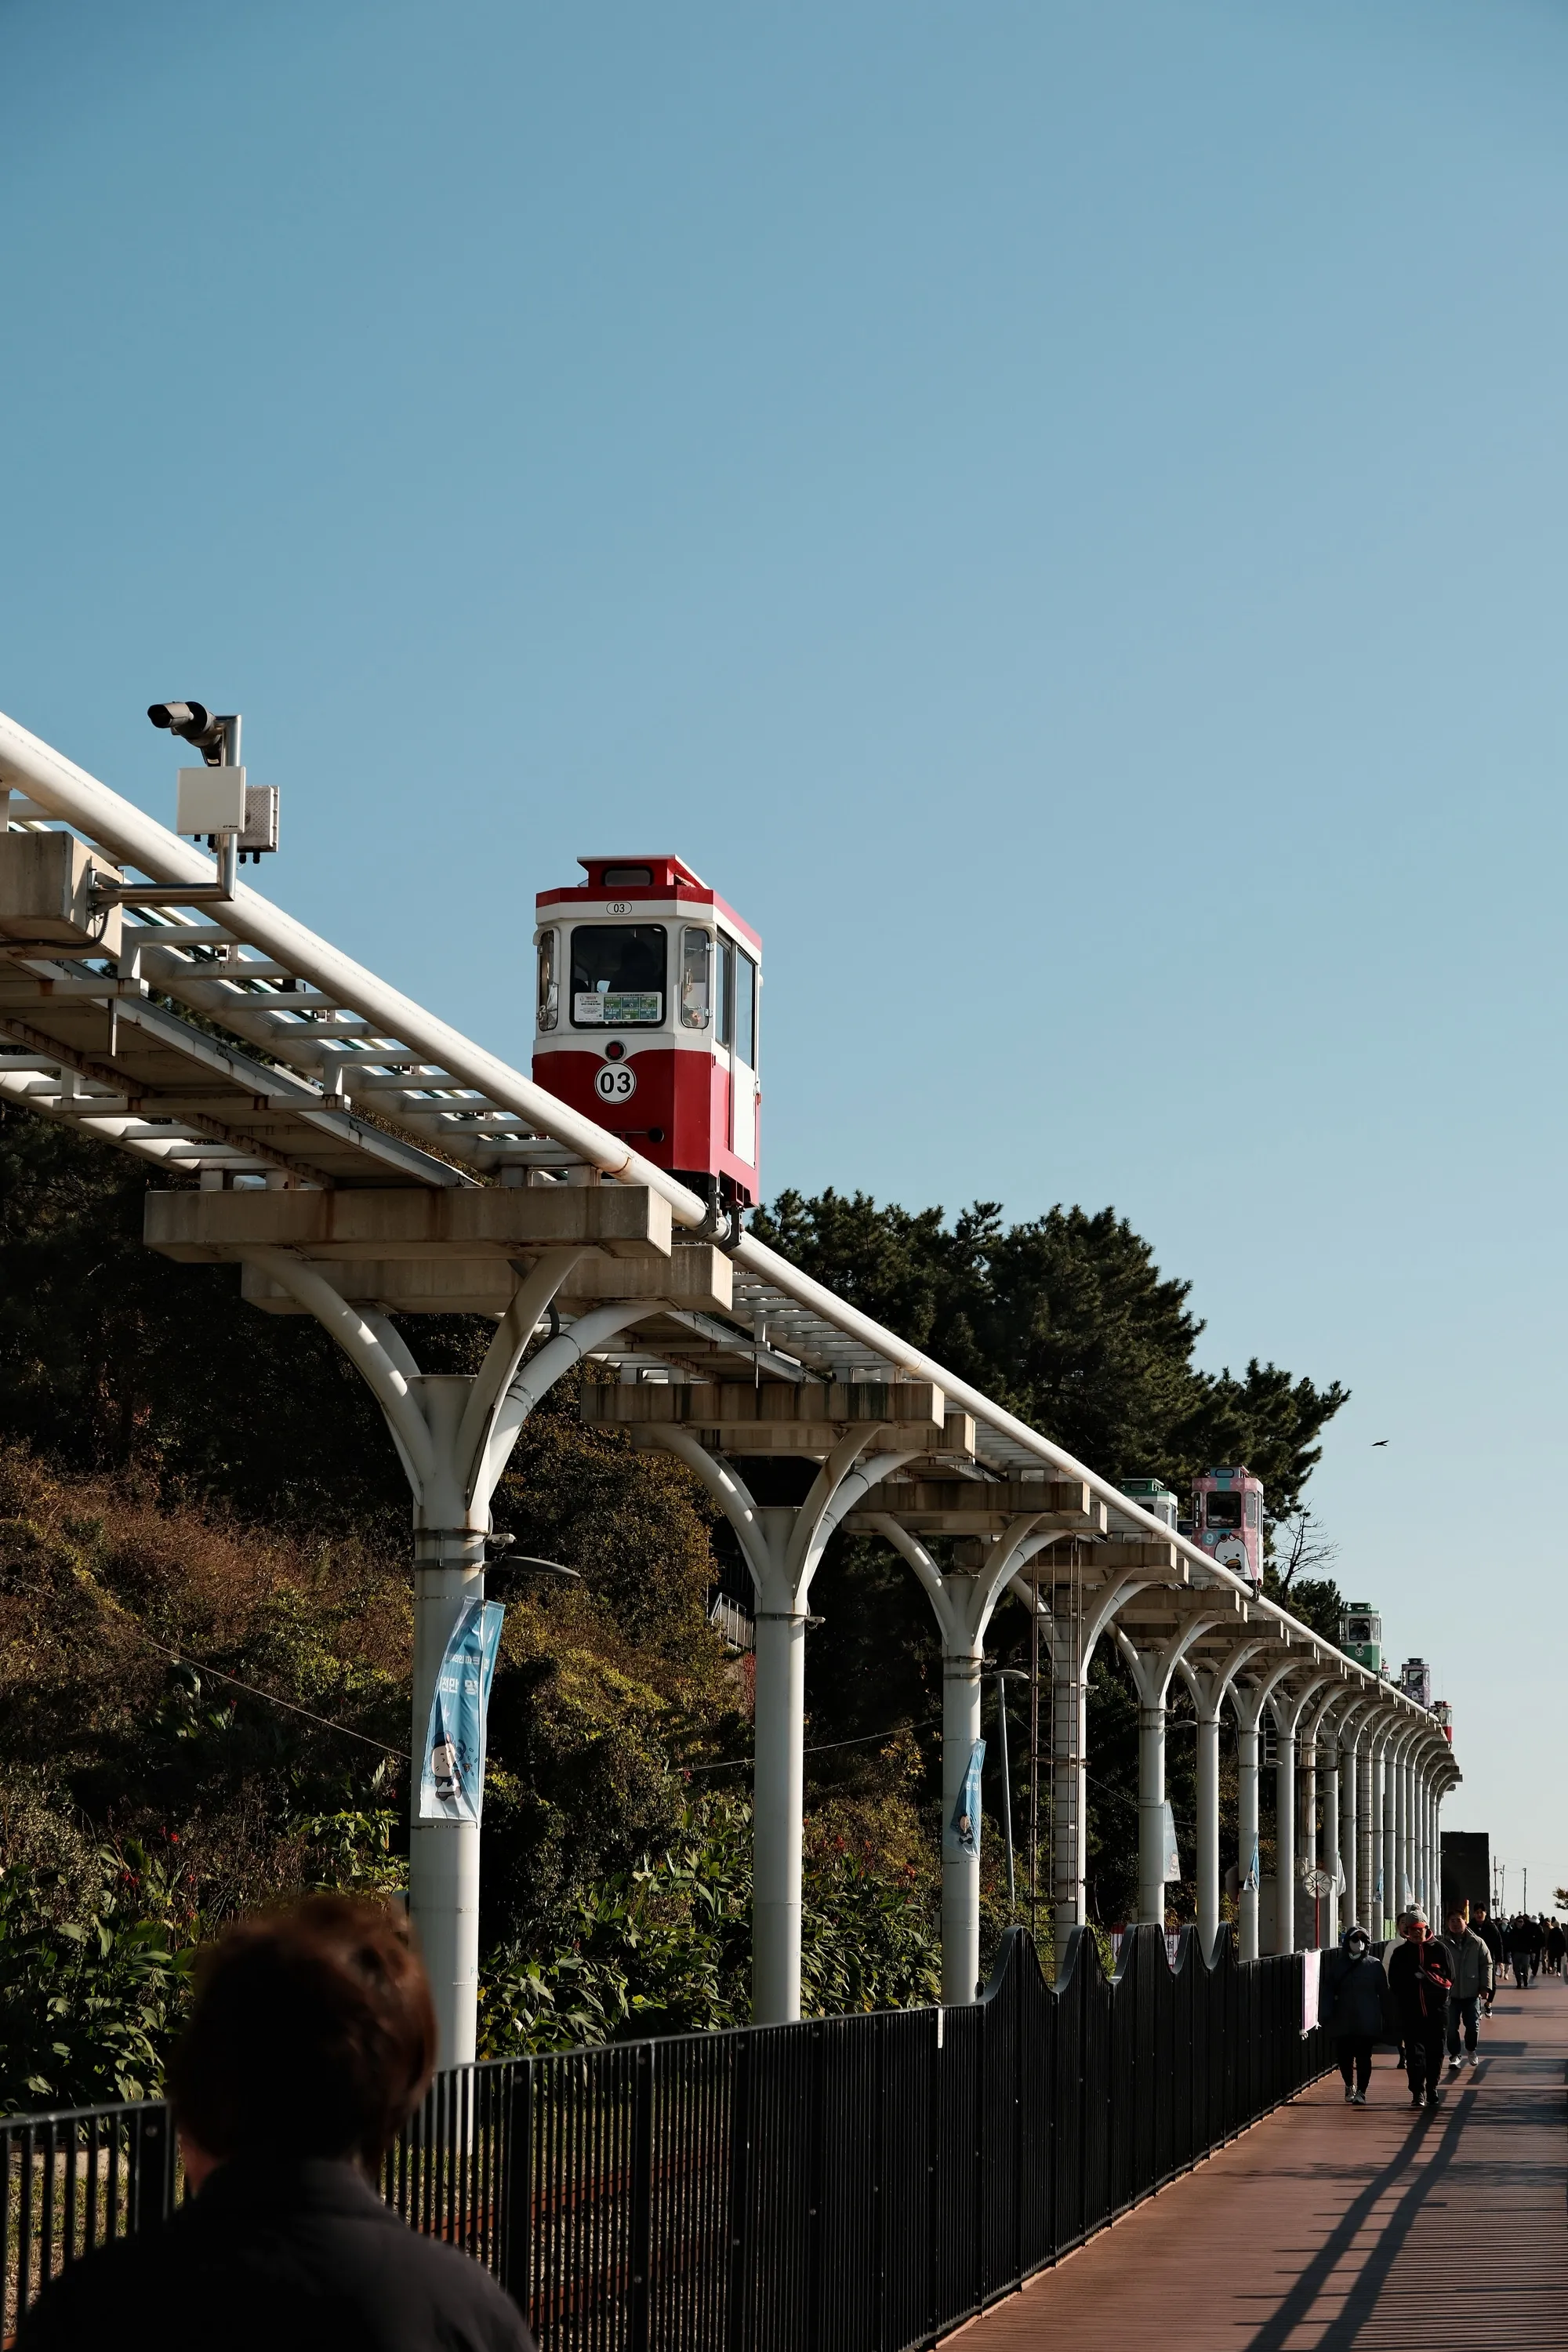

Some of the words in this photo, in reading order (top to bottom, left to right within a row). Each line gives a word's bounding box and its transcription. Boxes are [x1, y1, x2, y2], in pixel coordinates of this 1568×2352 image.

[614, 903, 625, 913] 03
[600, 1072, 631, 1094] 03
[1206, 1533, 1214, 1544] 9
